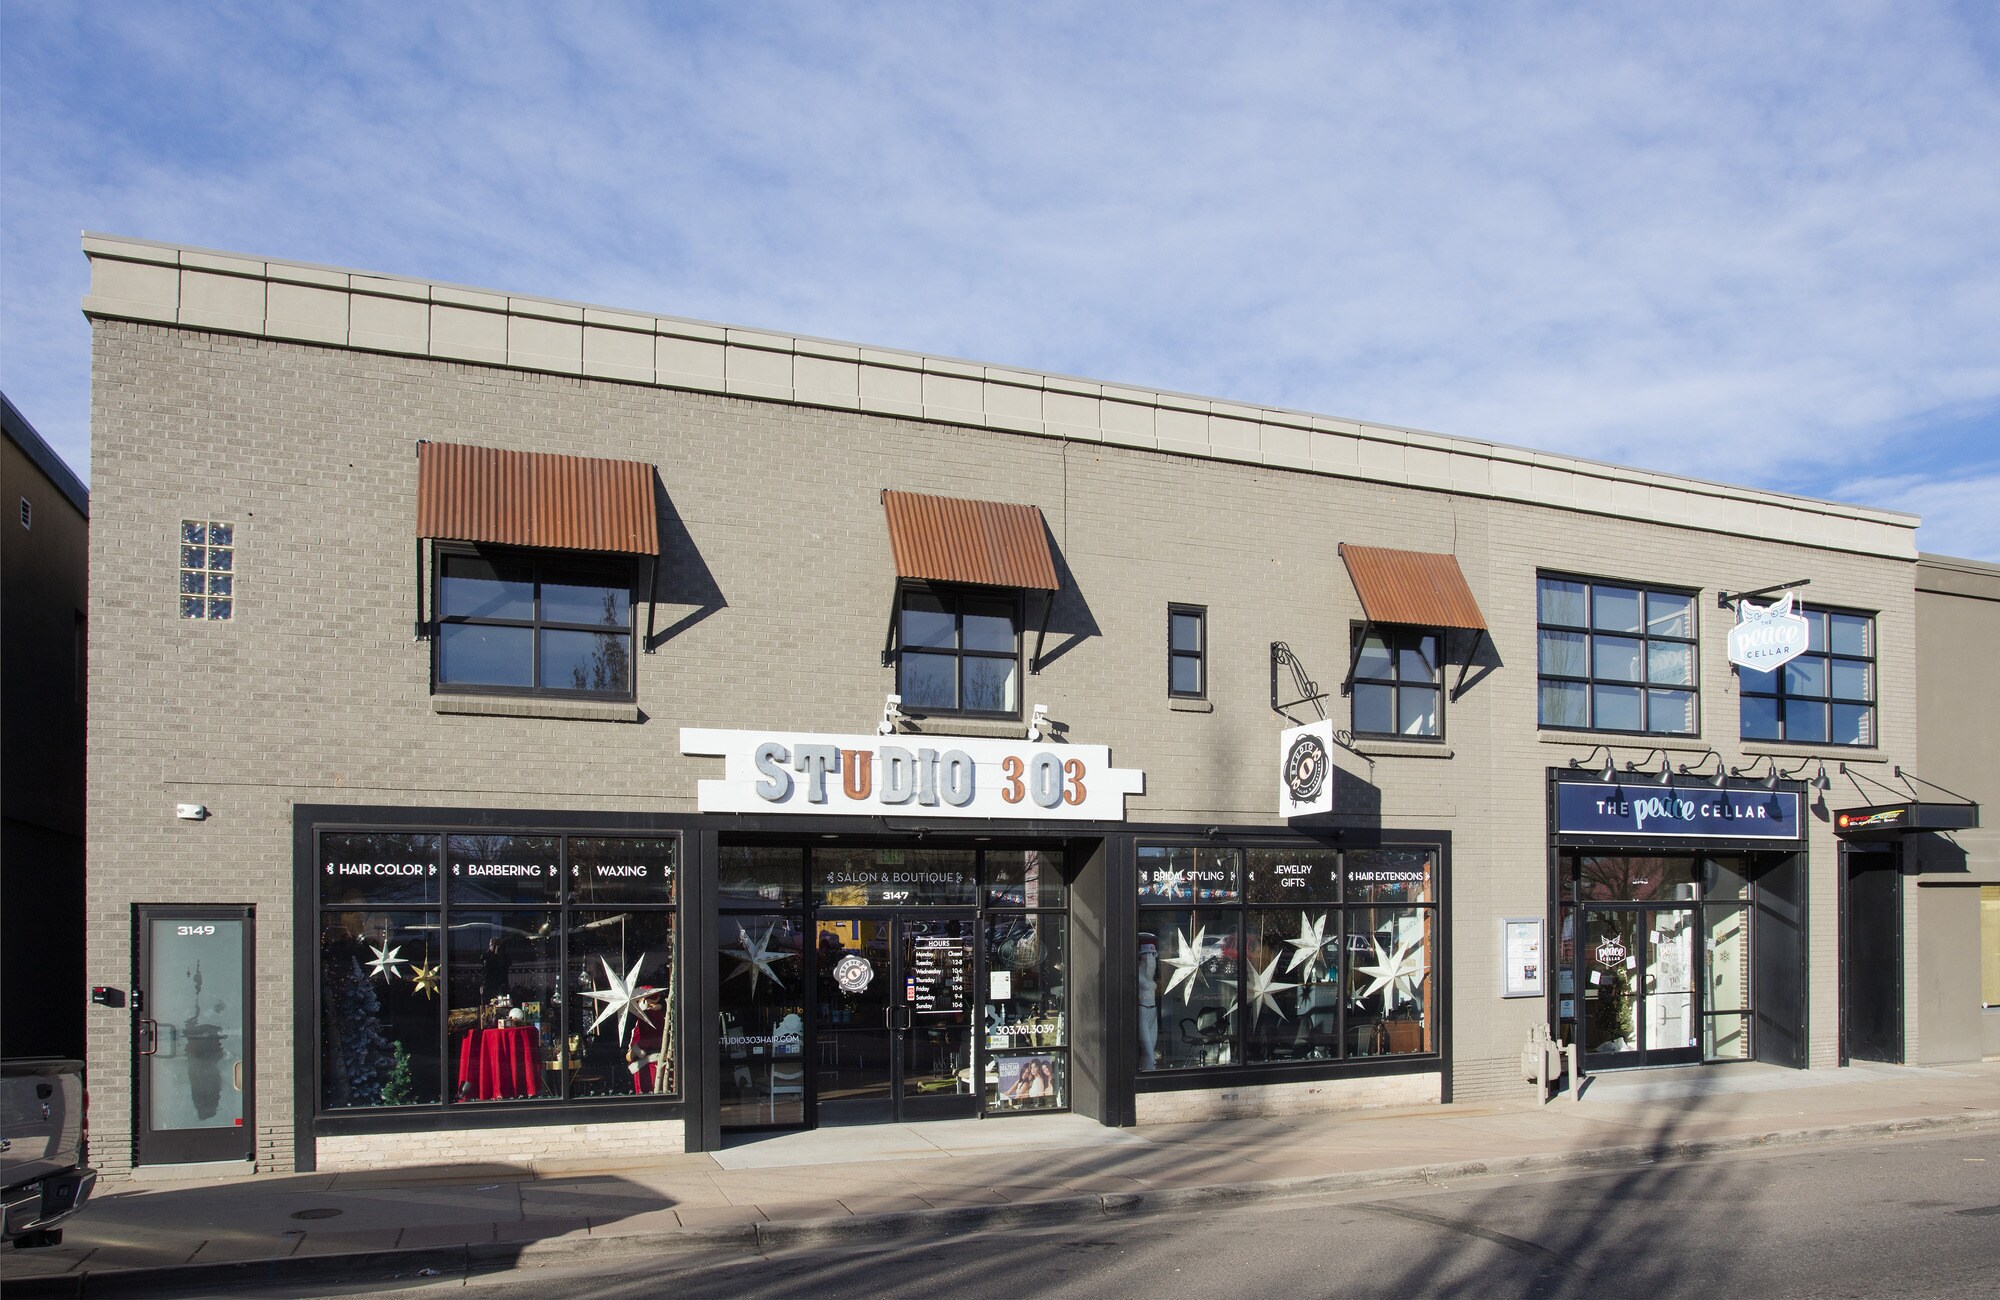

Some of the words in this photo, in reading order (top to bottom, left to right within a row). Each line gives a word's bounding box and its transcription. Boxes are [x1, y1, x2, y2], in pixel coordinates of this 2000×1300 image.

[1737, 625, 1799, 660] peace
[1747, 646, 1790, 659] CELLAR
[755, 741, 975, 808] STUDIO
[1001, 751, 1088, 810] 303
[1596, 800, 1629, 815] THE
[1633, 796, 1696, 830] peace
[1700, 804, 1767, 819] CELLAR
[339, 863, 371, 875] HAIR
[374, 863, 423, 876] COLOR
[468, 864, 542, 876] BARBERING
[596, 865, 648, 877] WAXING
[1274, 865, 1313, 874] JEWELRY
[837, 872, 877, 882] SALON
[881, 872, 889, 882] &
[893, 872, 954, 883] BOUTIQUE
[1153, 871, 1184, 881] BRIDAL
[1186, 871, 1225, 881] STYLING
[1355, 872, 1375, 881] HAIR
[1375, 872, 1424, 881] EXTENSIONS
[1281, 878, 1306, 888] GIFTS
[882, 891, 909, 900] 3147
[177, 925, 216, 936] 3149
[1599, 947, 1625, 961] peace
[995, 1024, 1055, 1035] 303.761.3039
[719, 1035, 799, 1045] TUDIO303HAIR.COM
